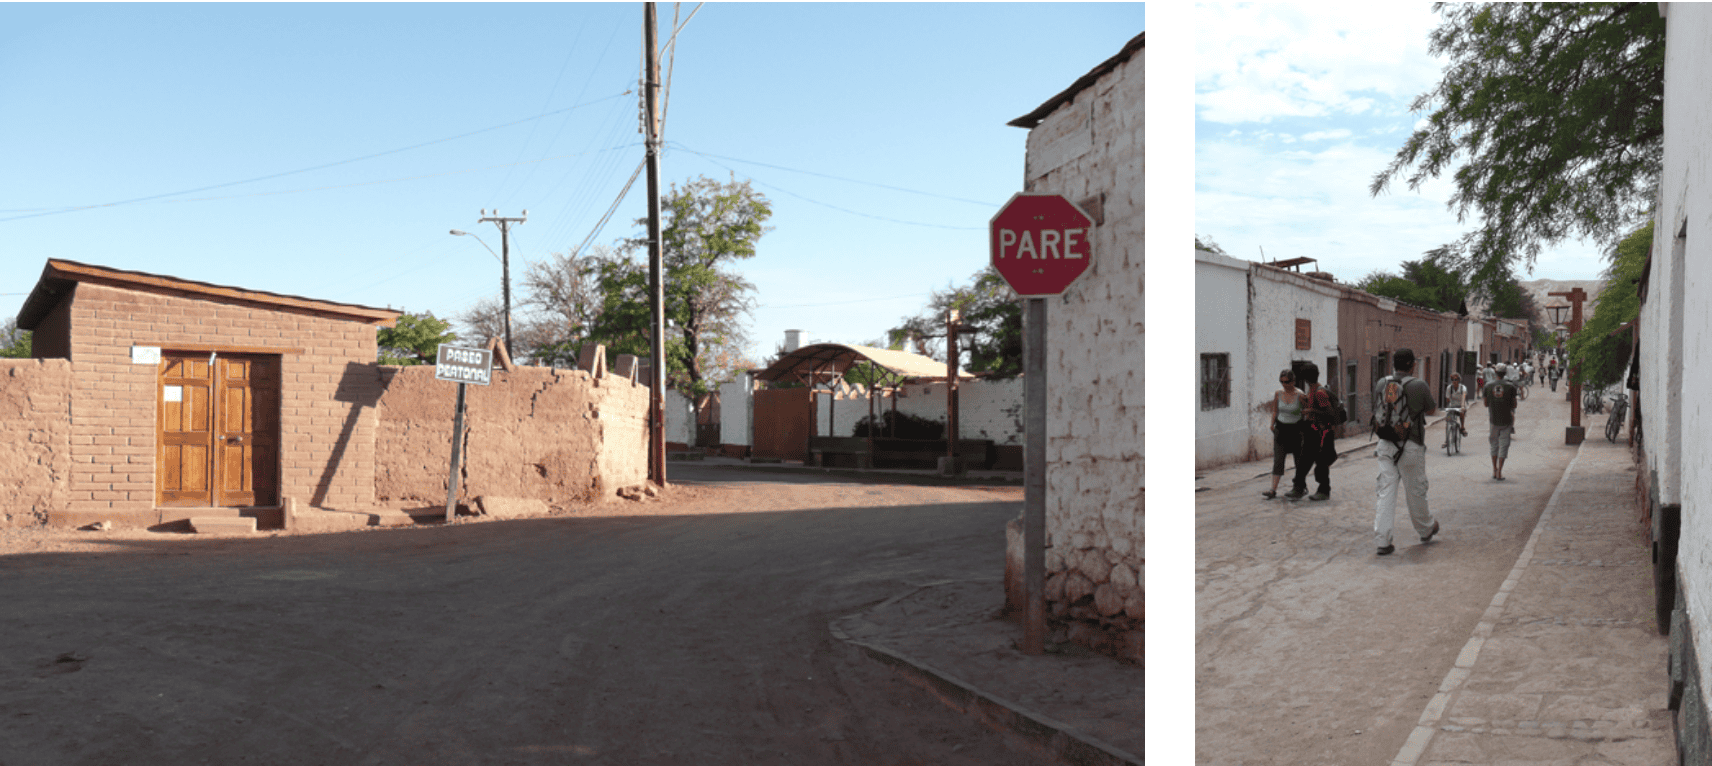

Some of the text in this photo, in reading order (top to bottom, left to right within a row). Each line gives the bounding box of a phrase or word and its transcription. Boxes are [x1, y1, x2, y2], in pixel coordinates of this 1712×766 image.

[999, 228, 1084, 260] PARE
[446, 348, 482, 364] PASEO
[437, 363, 488, 381] PEATONAL
